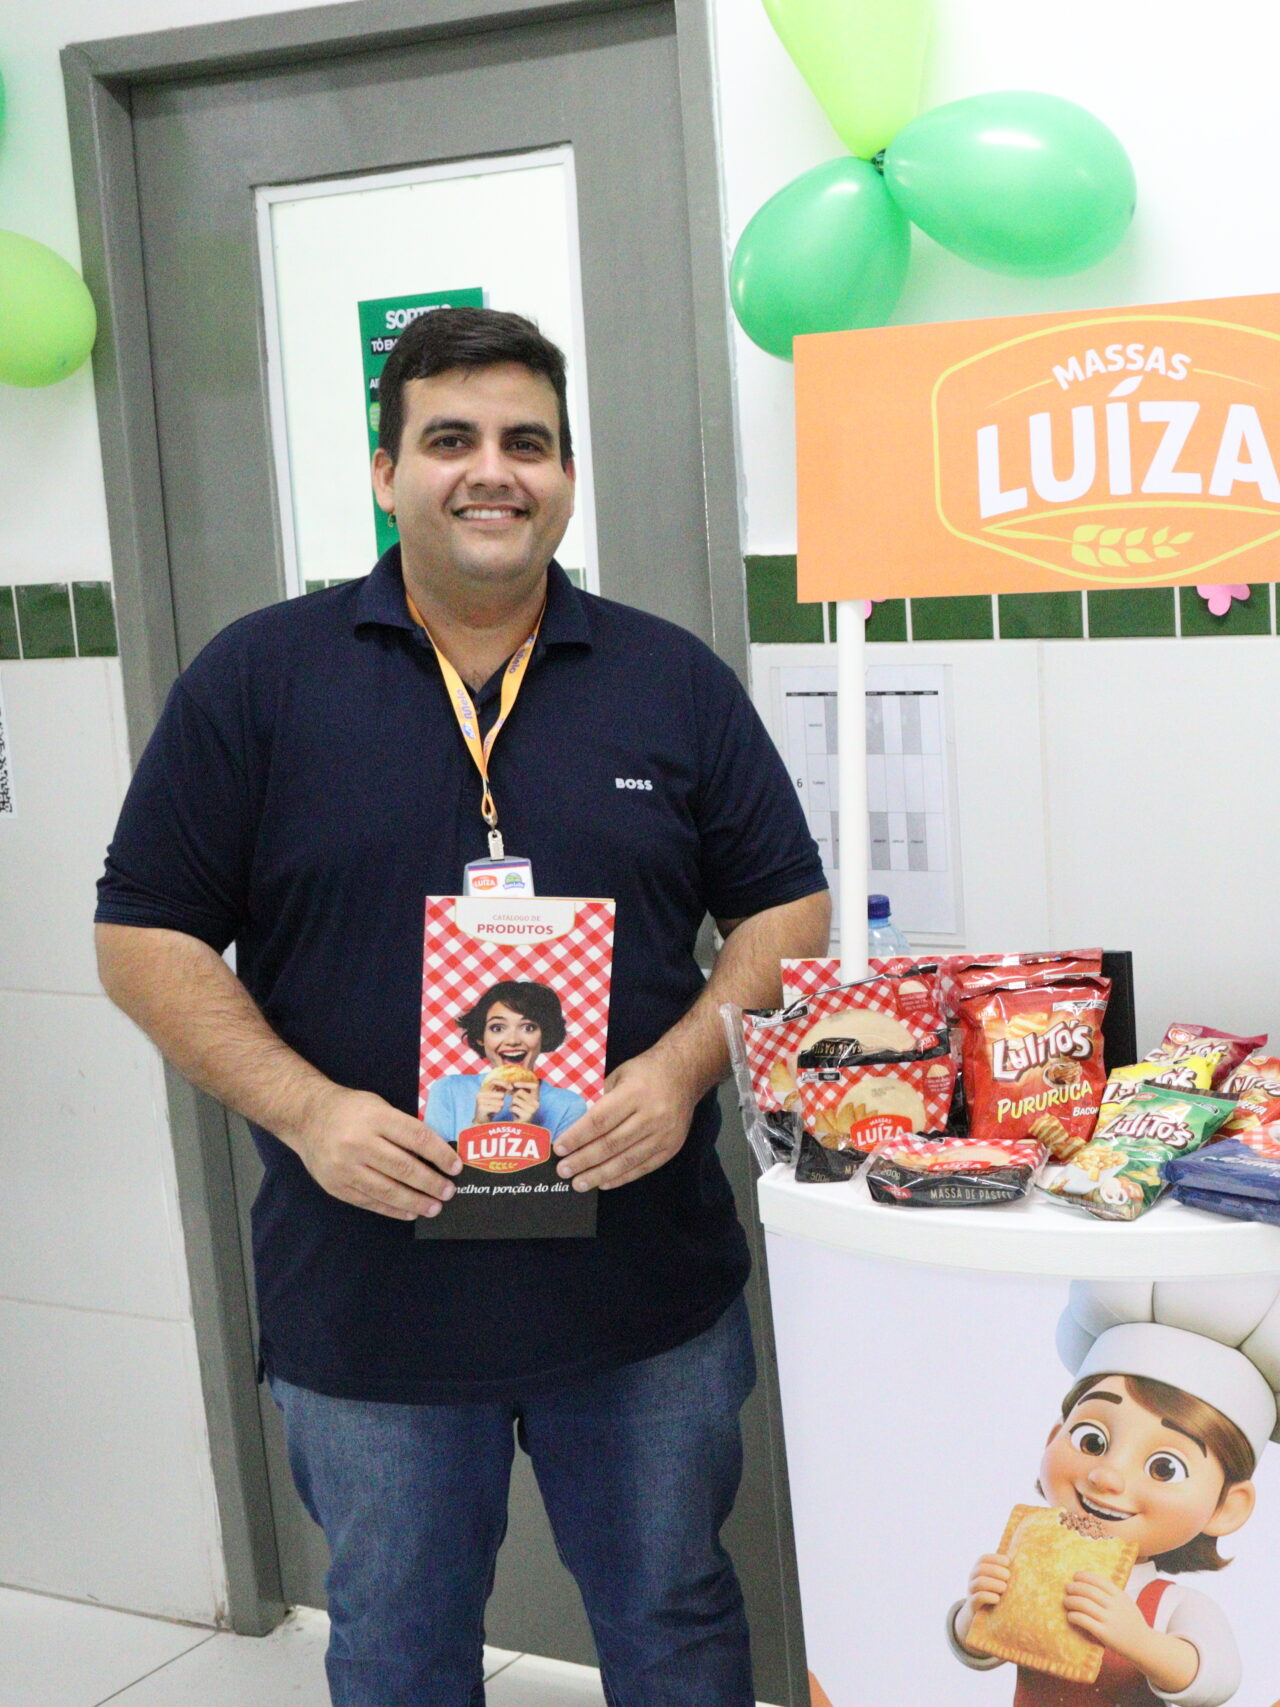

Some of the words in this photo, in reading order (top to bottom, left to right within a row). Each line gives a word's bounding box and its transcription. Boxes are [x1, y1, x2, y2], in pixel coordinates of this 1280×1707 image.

[1052, 343, 1193, 391] MASSAS
[615, 778, 653, 791] BOSS
[477, 923, 554, 935] PRODUTOS
[997, 1080, 1093, 1123] PURURUCA
[488, 1126, 522, 1136] MASSAS
[466, 1134, 540, 1160] LUÍZA
[492, 1183, 532, 1195] porção
[534, 1183, 549, 1193] do
[550, 1181, 570, 1192] dia
[930, 1188, 962, 1200] MASSA
[965, 1189, 976, 1199] DE
